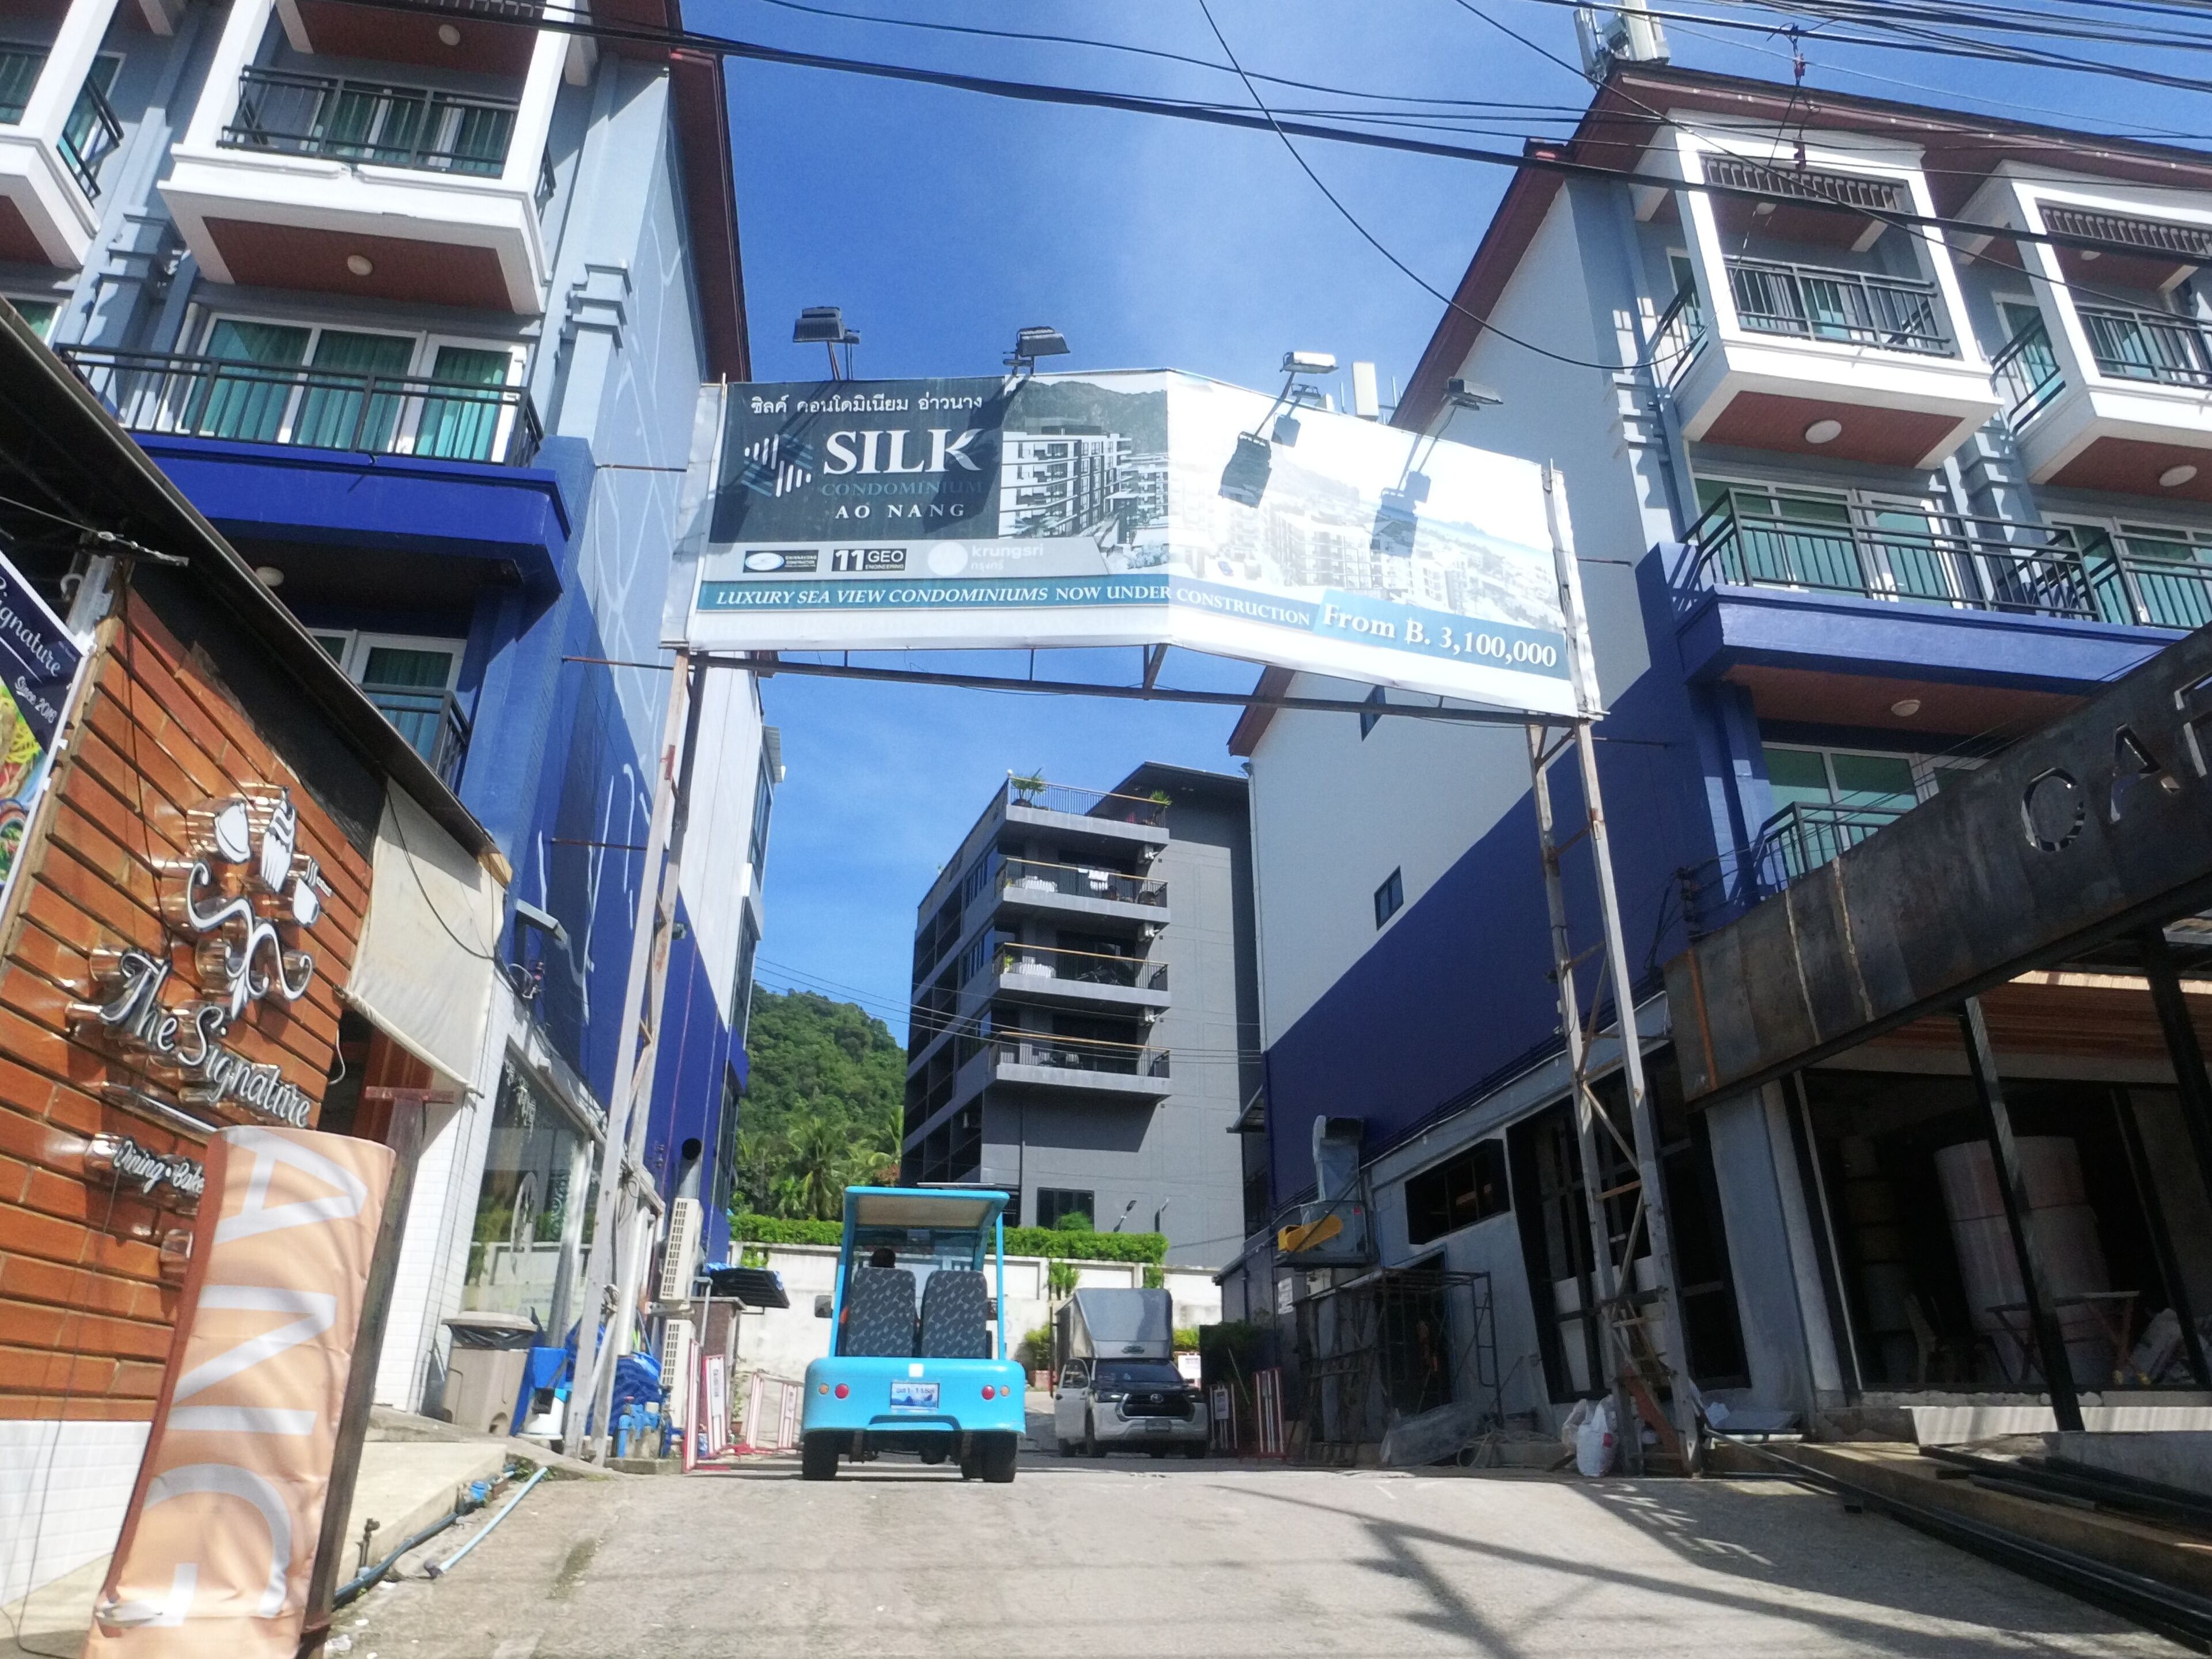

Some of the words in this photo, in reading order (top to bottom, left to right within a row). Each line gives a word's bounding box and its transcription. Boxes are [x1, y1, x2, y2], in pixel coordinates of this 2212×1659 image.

[751, 394, 789, 414] ซิลค์
[797, 393, 908, 414] คอนโดมิเนียม
[918, 392, 983, 411] อ่าวนาง
[823, 427, 985, 475] SILK
[820, 480, 984, 498] CONDOMINIUM
[835, 504, 871, 520] AO
[887, 503, 965, 518] NANG
[834, 550, 865, 571] 11
[867, 550, 904, 563] GEO
[972, 543, 1044, 560] krungsri
[716, 590, 795, 605] LUXURY
[797, 590, 831, 604] SEA
[836, 589, 886, 603] VIEW
[889, 588, 1048, 603] CONDOMINIUMS
[1055, 587, 1100, 600] NOW
[1107, 586, 1172, 600] UNDER
[1176, 588, 1310, 626] CONSTRUCTION
[1323, 603, 1396, 639] From
[1439, 626, 1557, 668] 3,100,000
[99, 952, 180, 1051] The
[177, 1005, 312, 1129] Signature
